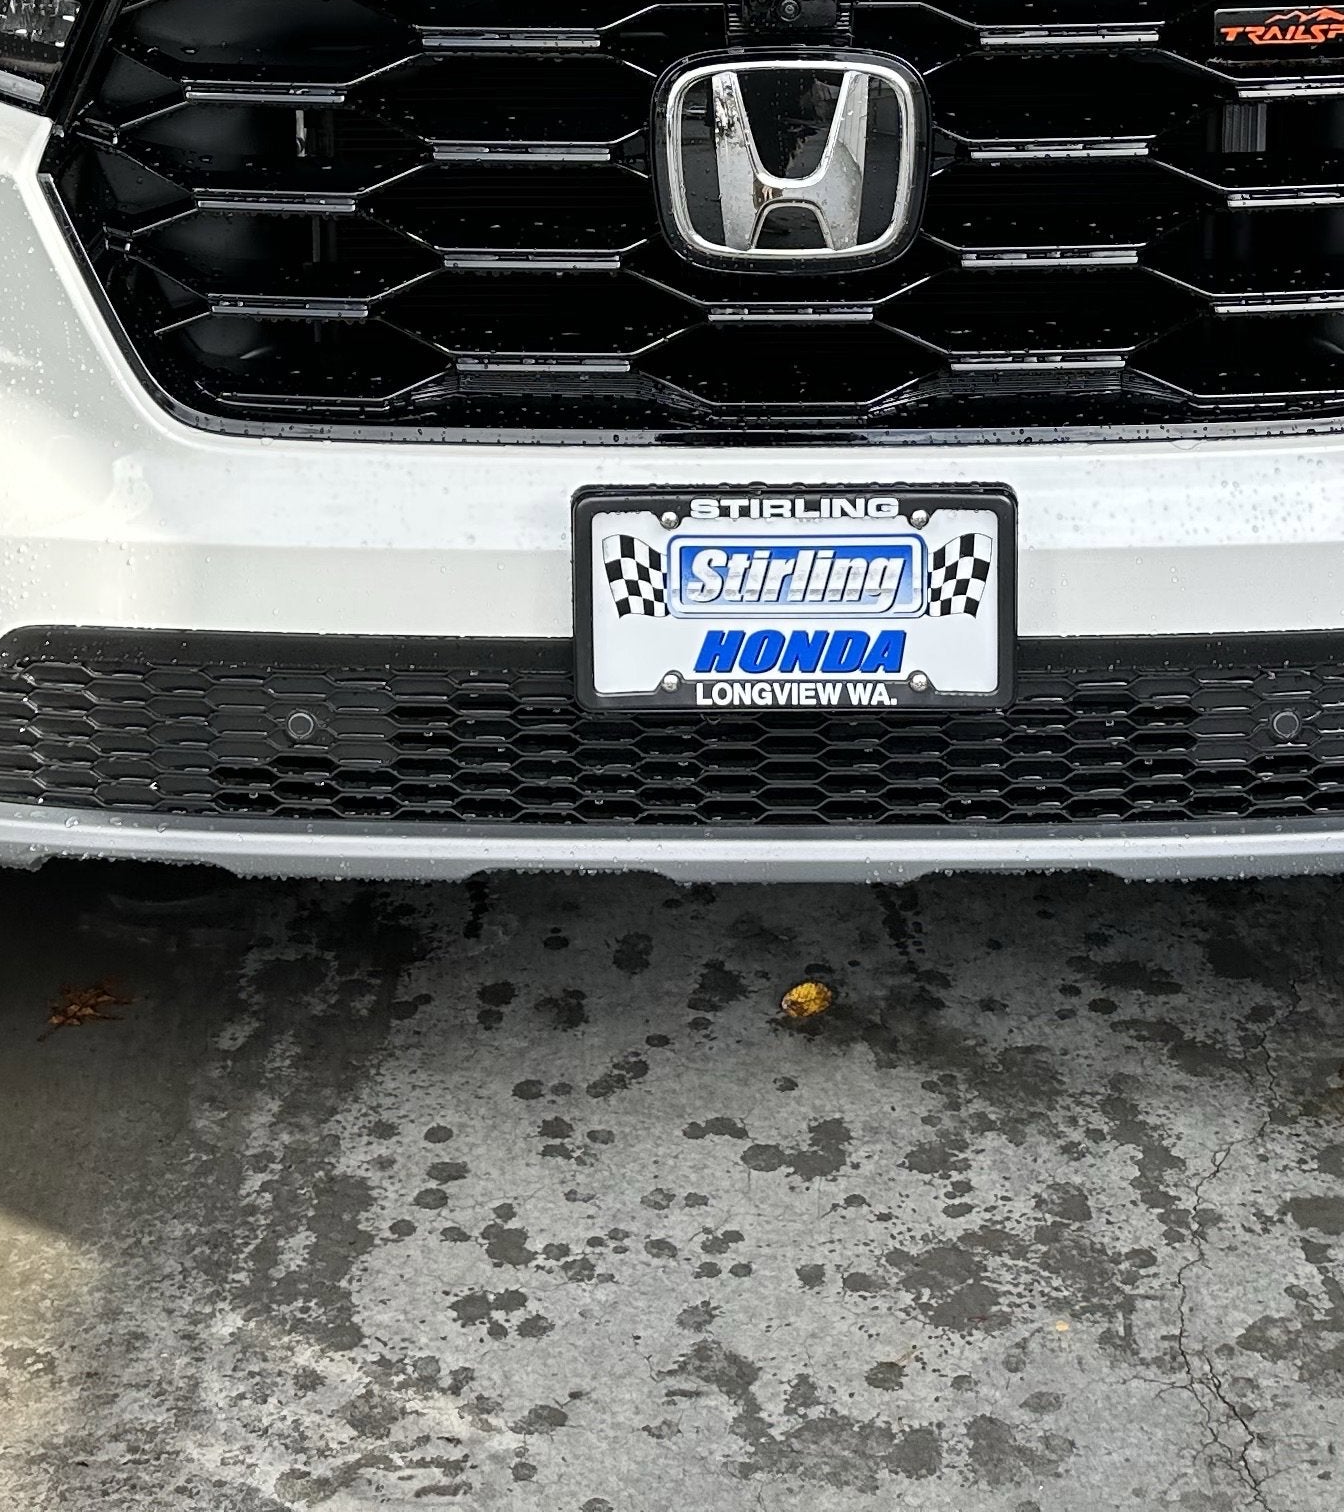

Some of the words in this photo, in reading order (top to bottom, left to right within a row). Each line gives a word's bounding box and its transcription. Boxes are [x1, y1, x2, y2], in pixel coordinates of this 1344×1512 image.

[690, 498, 899, 519] STIRLING
[689, 548, 906, 612] Stirling
[694, 629, 907, 673] HONDA
[696, 683, 846, 705] LONGVIEW
[847, 683, 897, 705] WA.
